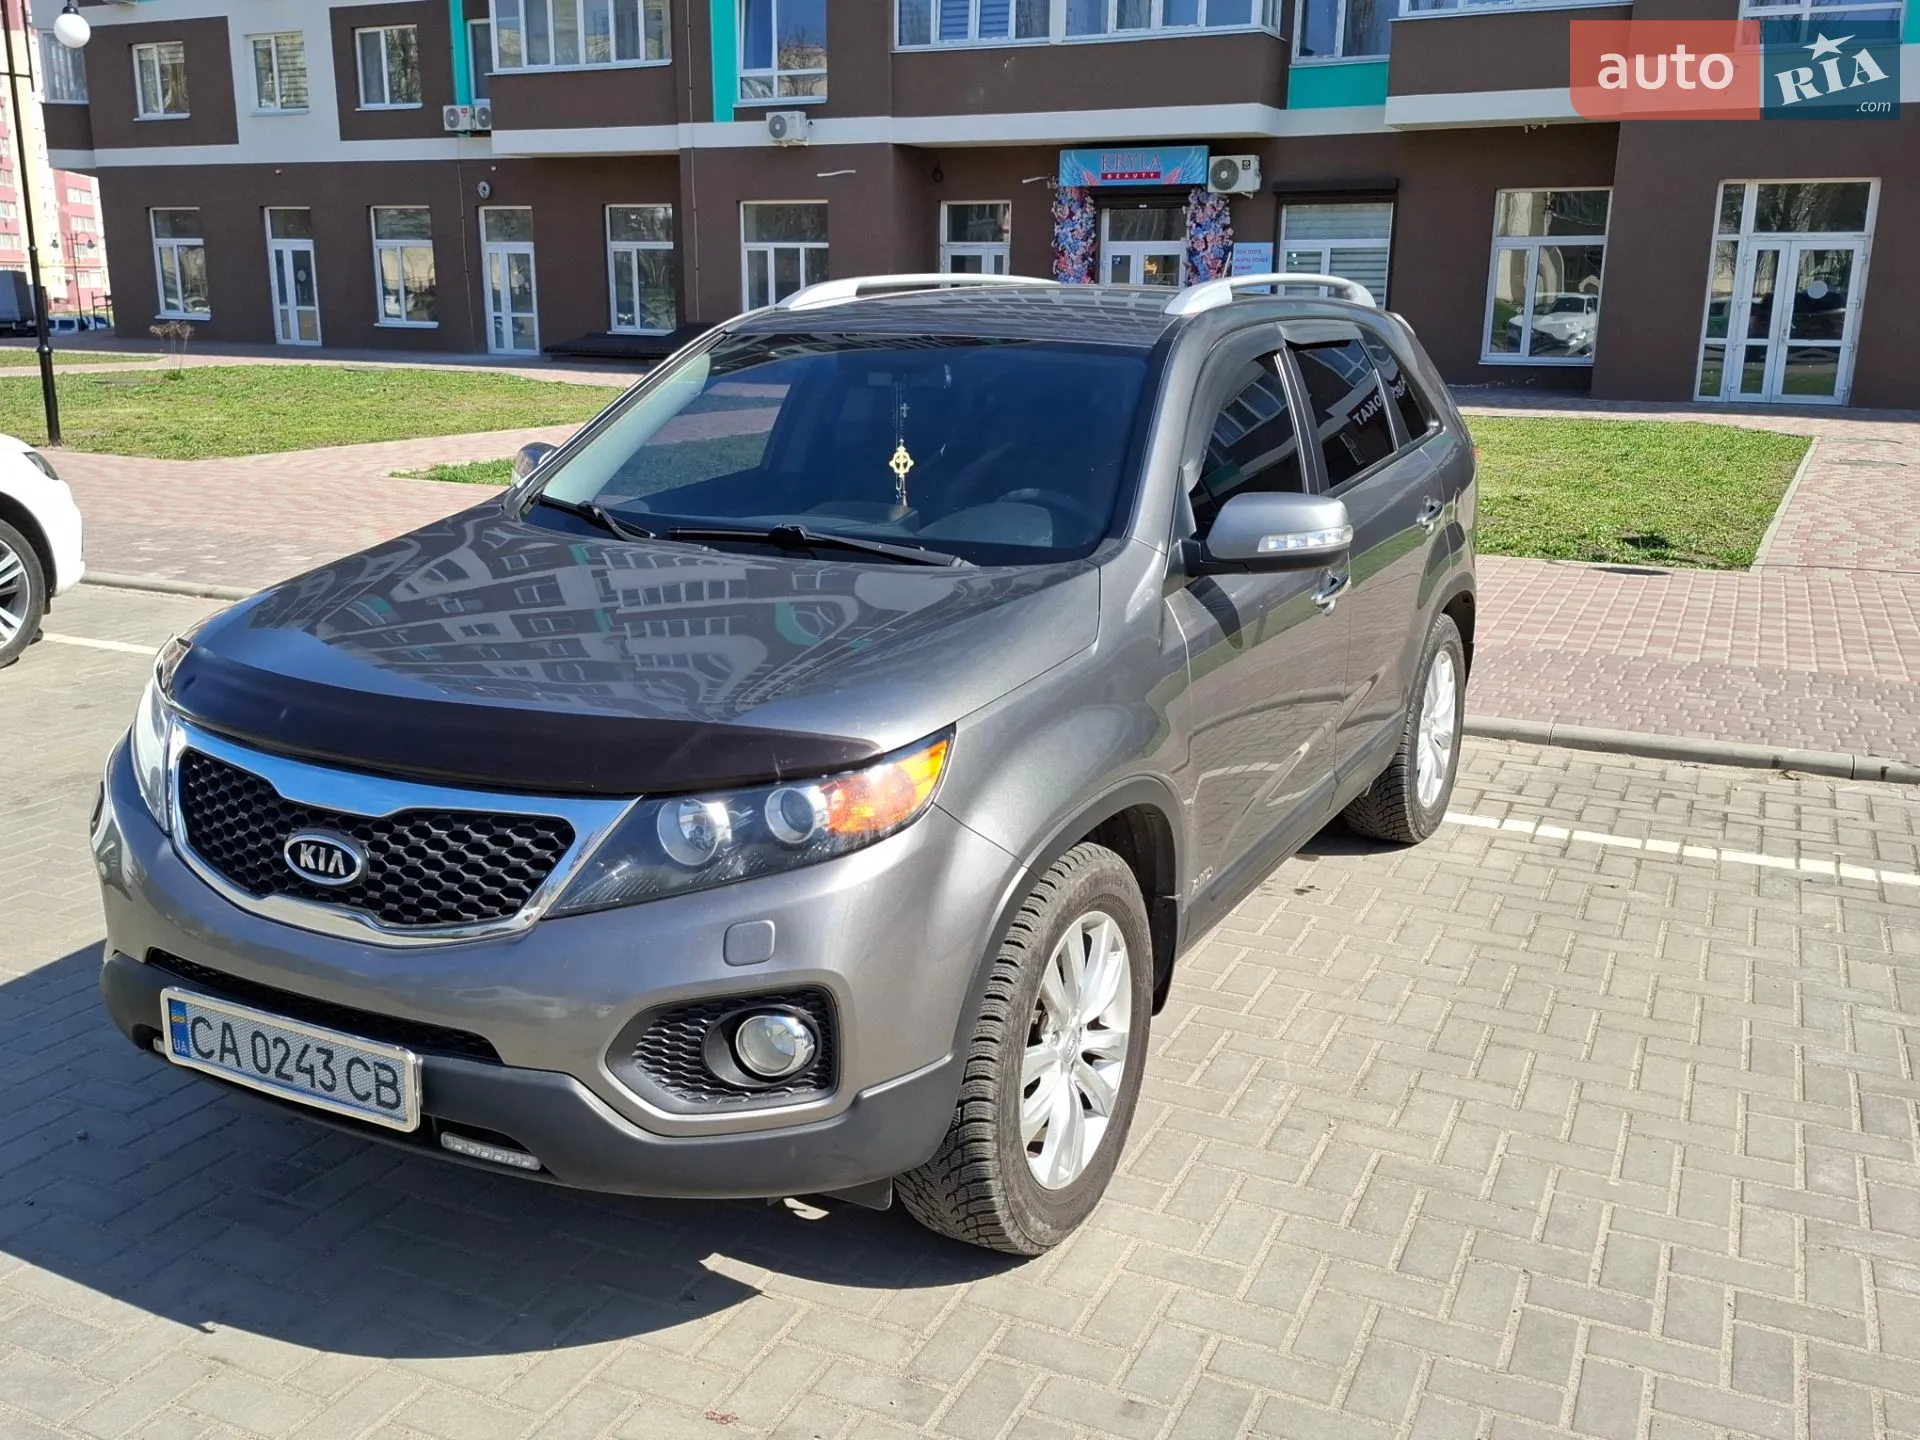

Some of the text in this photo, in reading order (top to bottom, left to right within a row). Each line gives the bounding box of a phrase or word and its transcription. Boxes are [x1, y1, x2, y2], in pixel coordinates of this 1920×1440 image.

[1101, 152, 1162, 171] KRYLA
[300, 842, 346, 876] KIA
[173, 1038, 189, 1054] UA
[190, 1016, 402, 1110] CA 0243 CB
